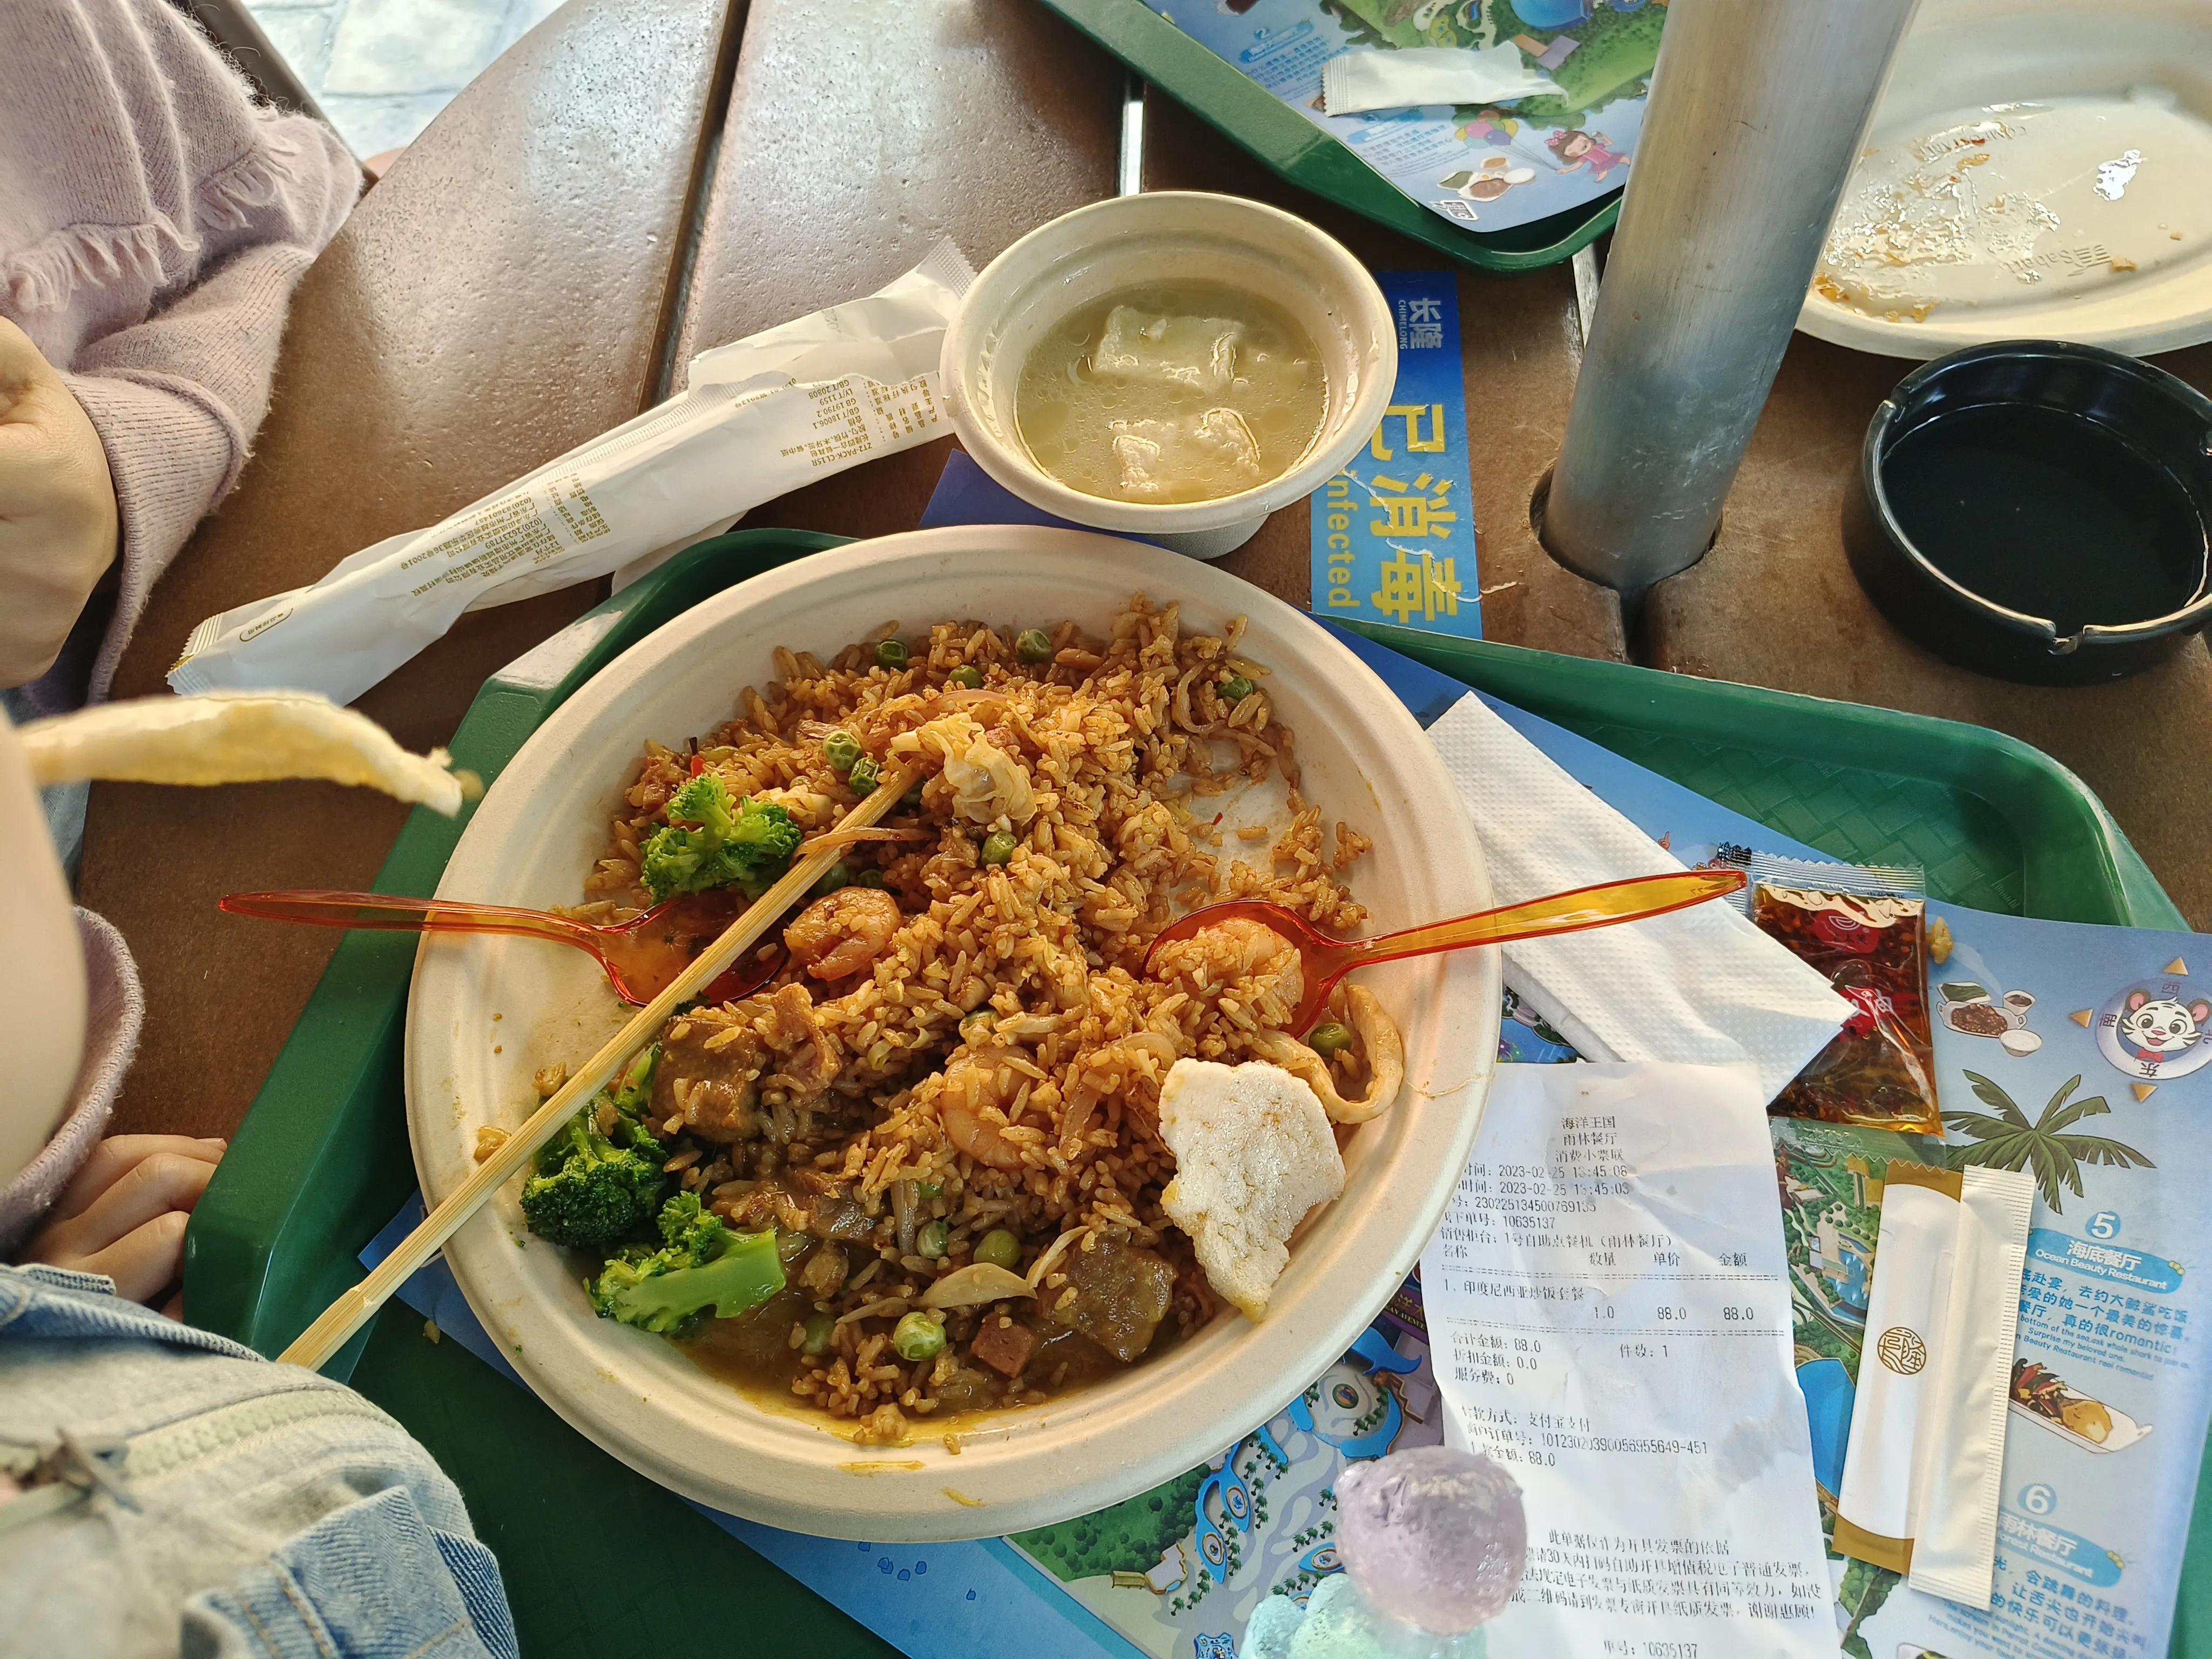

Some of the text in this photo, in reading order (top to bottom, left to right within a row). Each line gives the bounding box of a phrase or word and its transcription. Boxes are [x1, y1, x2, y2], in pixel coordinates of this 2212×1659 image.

[1255, 26, 1270, 40] 2
[1398, 300, 1407, 350] CHIMELONG
[1409, 298, 1442, 349] 长隆
[808, 386, 831, 399] 20808
[832, 379, 849, 390] GB/T
[819, 388, 853, 405] LY/T 1159
[845, 397, 856, 406] GB
[812, 413, 841, 429] 18006.1
[1370, 404, 1461, 623] 已消毒
[1327, 470, 1359, 608] infected
[2162, 981, 2182, 994] 西
[1561, 1116, 1615, 1129] 海洋王国
[1563, 1132, 1617, 1145] 雨林餐厅
[1500, 1182, 1566, 1196] 2023-02-25
[2091, 1213, 2114, 1238] 5
[1444, 1244, 1748, 1267] 名称 数量 单价 金额
[2067, 1240, 2142, 1272] 海底餐厅
[2035, 1248, 2168, 1290] Ocean Beauty Restaurant
[1595, 1306, 1754, 1321] 1.0 88.0 88.0
[2020, 1314, 2048, 1329] bottom
[2061, 1327, 2074, 1337] the
[2024, 1336, 2051, 1350] Beauty
[2028, 1327, 2061, 1343] Surprise
[2063, 1339, 2075, 1348] my
[2025, 1486, 2051, 1514] 6
[1999, 1512, 2078, 1556] 雨林餐厅
[1999, 1533, 2029, 1552] orest
